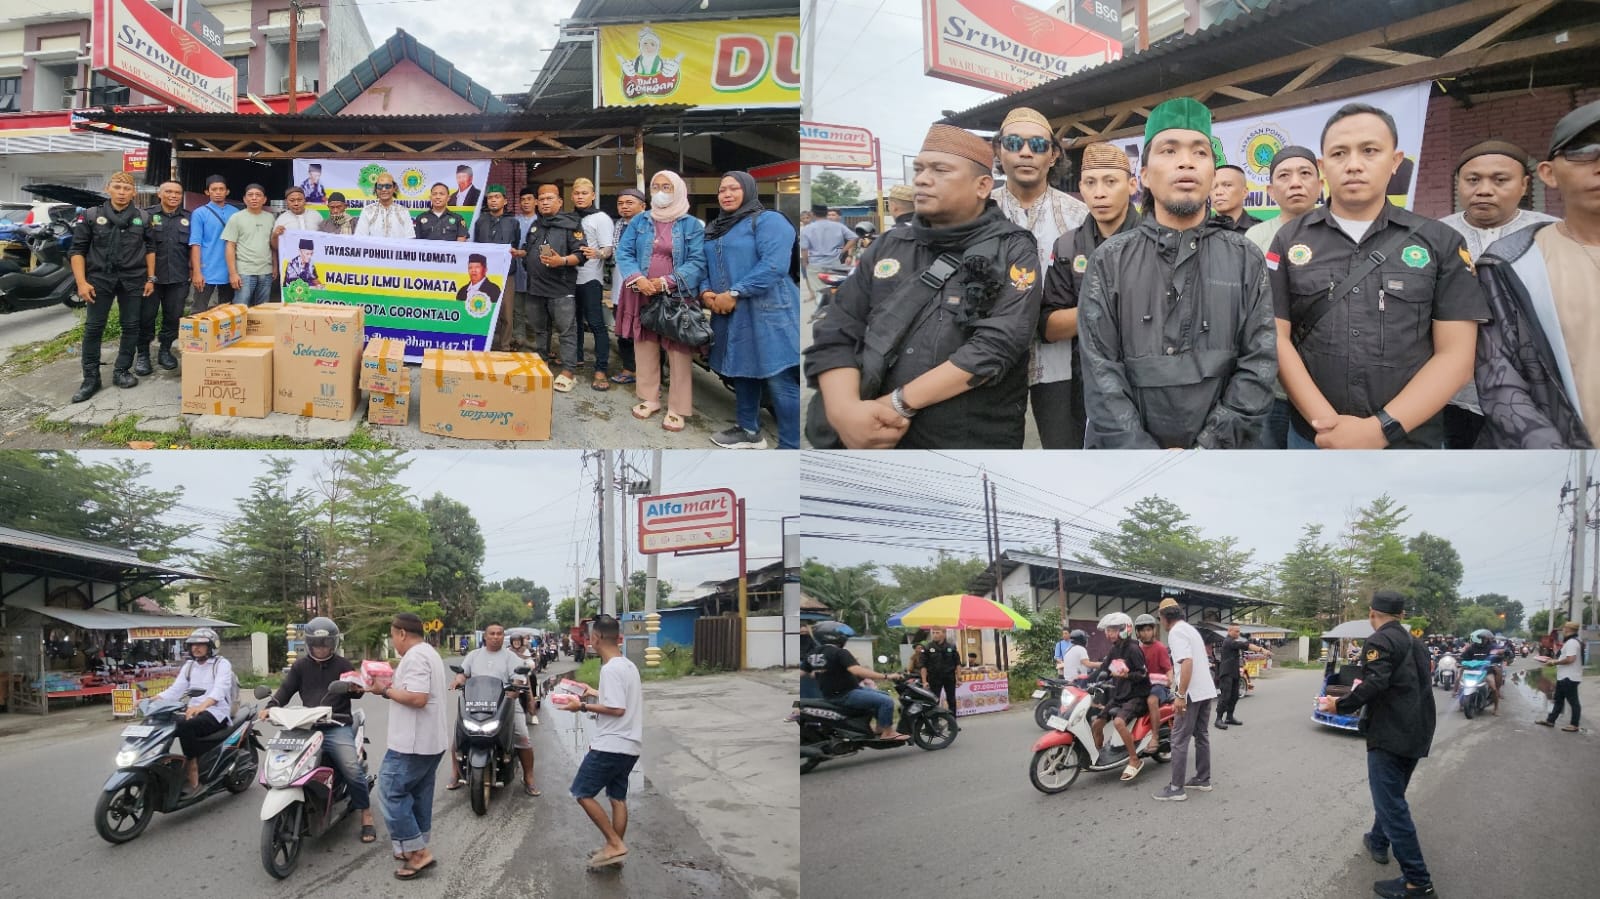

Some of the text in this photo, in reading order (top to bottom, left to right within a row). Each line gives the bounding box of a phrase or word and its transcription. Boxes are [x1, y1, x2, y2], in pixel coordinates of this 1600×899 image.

[1096, 1, 1118, 22] BSG
[203, 24, 220, 46] BSG
[943, 16, 1068, 73] Sriwijaya
[118, 24, 208, 90] Sriwijaya
[212, 85, 232, 103] Air
[949, 57, 990, 77] WARUNG
[324, 245, 457, 264] YAYASAN POHULI ILMU ILOMATA
[325, 271, 457, 293] MAJELIS ILMU ILOMATA
[389, 306, 460, 321] GORONTALO
[292, 343, 340, 358] Selection
[459, 409, 513, 426] Selection
[647, 496, 727, 517] Alfamart
